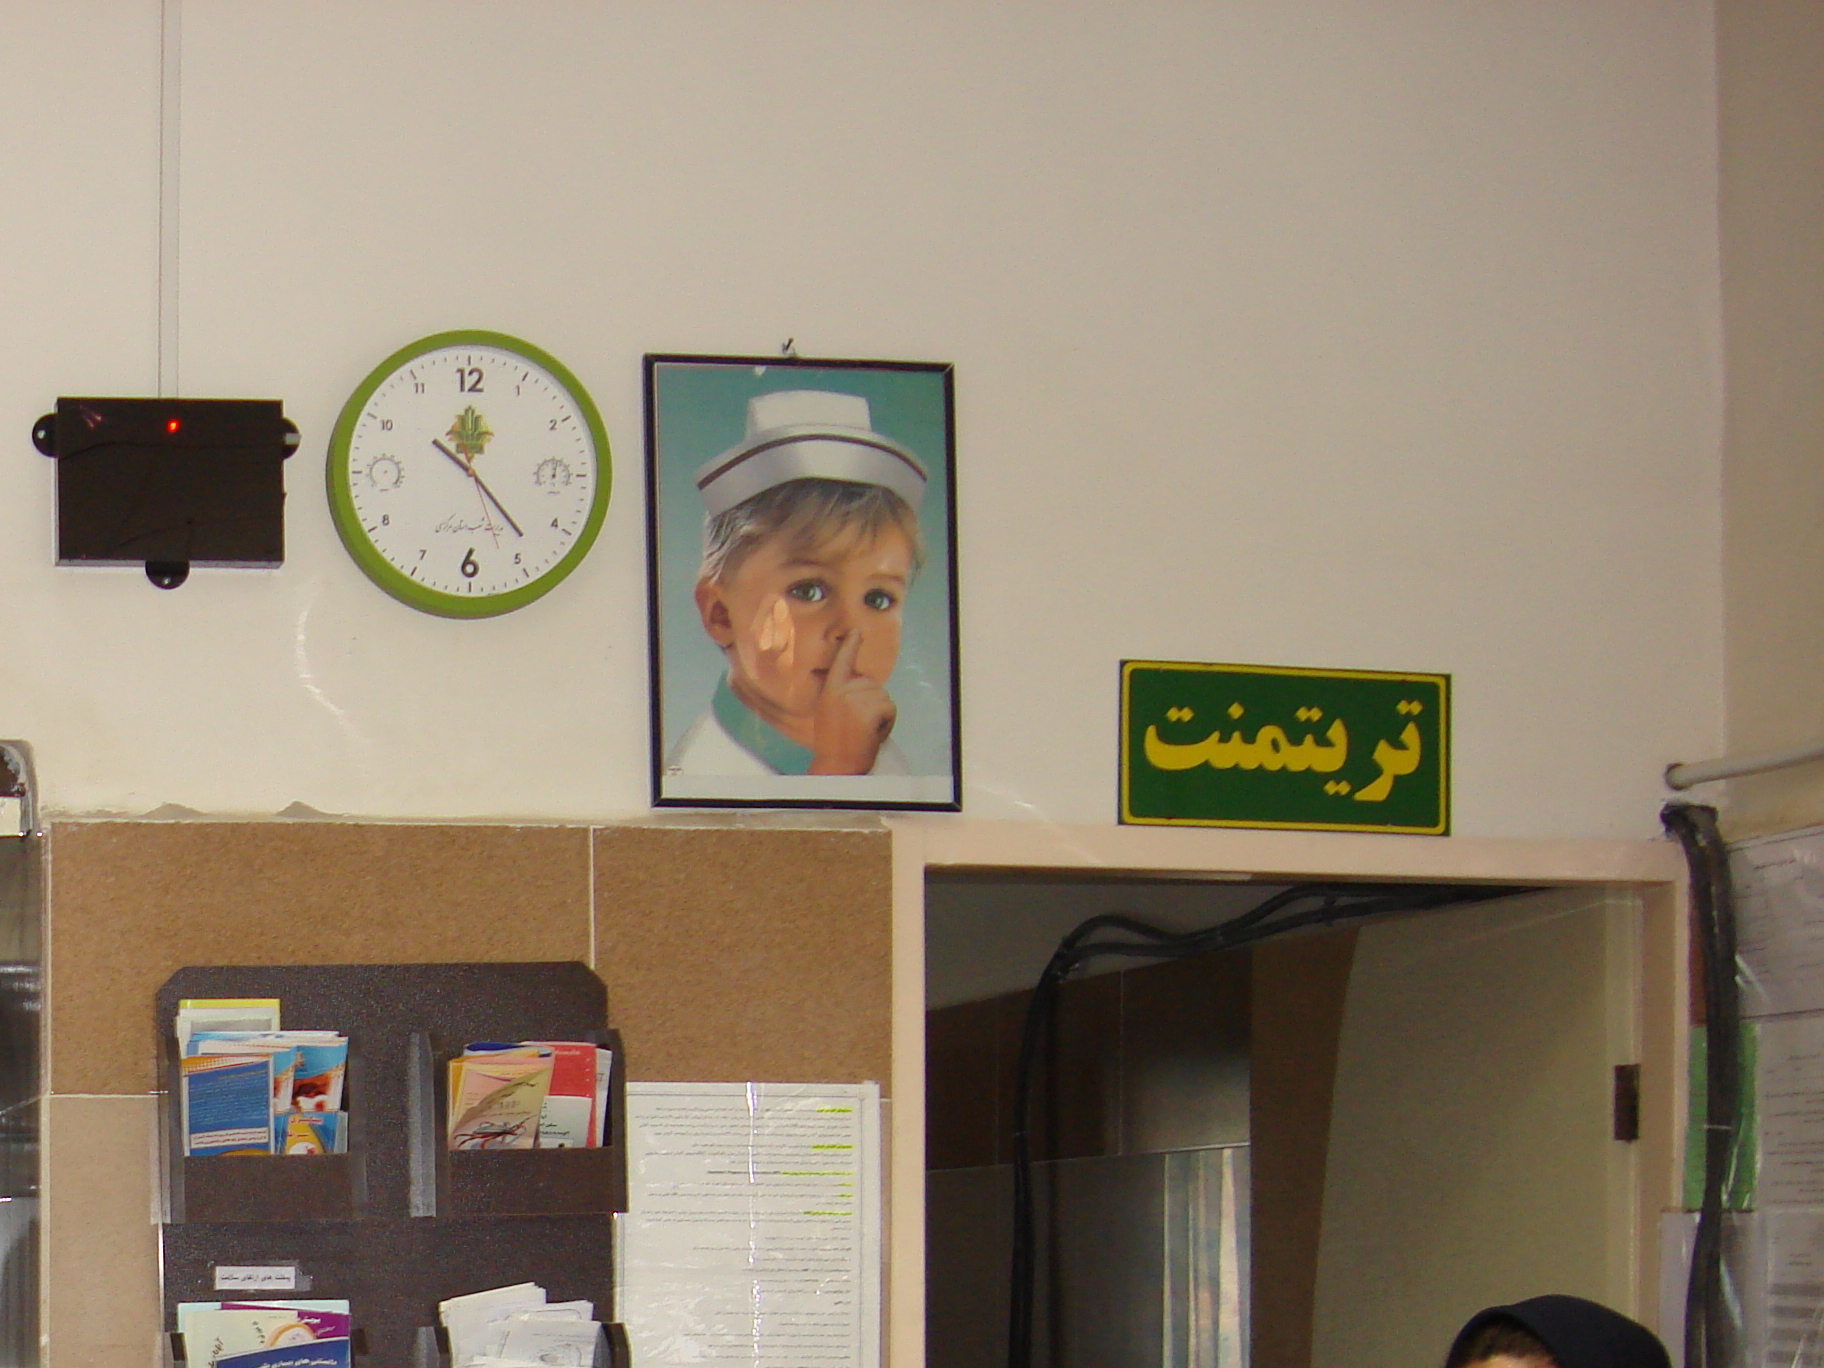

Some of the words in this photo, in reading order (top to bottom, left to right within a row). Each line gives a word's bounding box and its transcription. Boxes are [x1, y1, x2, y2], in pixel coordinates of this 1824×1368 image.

[456, 368, 485, 393] 12
[414, 383, 426, 394] 11
[381, 419, 393, 431] 10
[549, 419, 558, 431] 2
[382, 514, 390, 526] 8
[550, 517, 559, 529] 4
[419, 550, 428, 561] 7
[514, 553, 522, 565] 5
[461, 547, 480, 578] 6
[1143, 699, 1424, 803] تریتمنت
